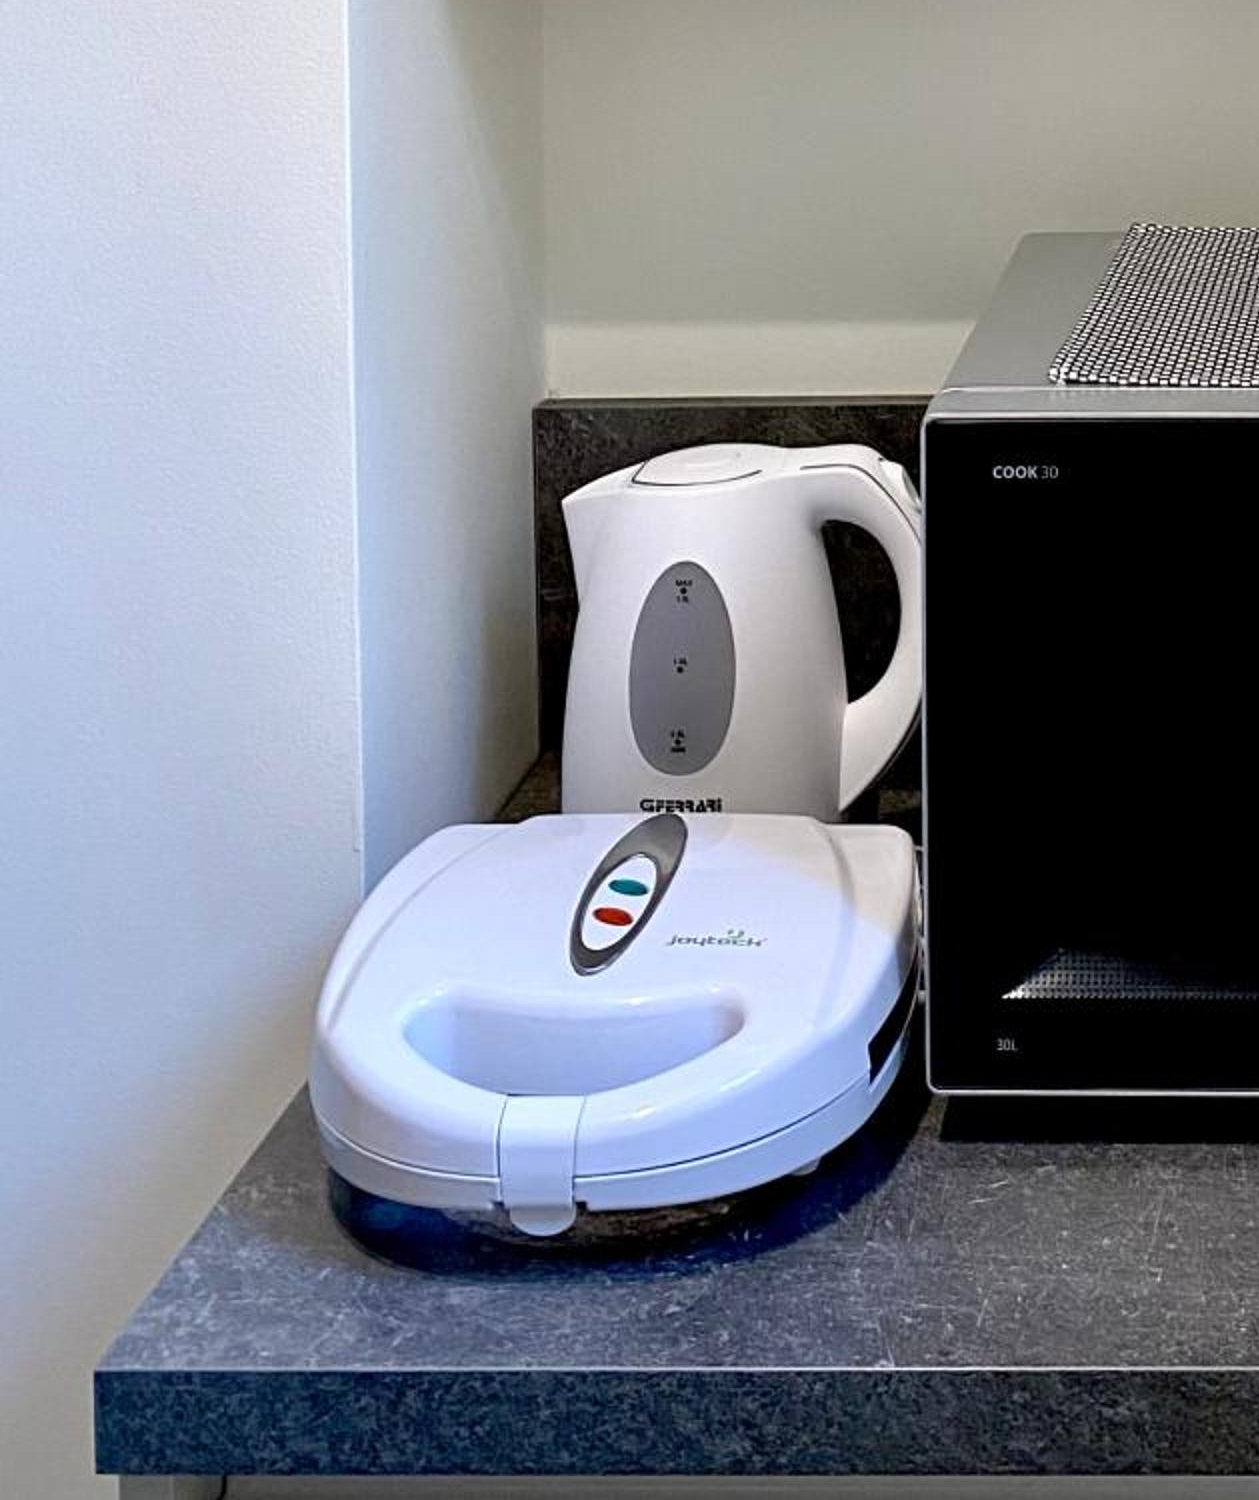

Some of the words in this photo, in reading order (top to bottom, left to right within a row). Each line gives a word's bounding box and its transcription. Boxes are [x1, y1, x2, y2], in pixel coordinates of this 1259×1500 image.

[992, 465, 1037, 479] COOK
[1041, 465, 1058, 479] 30
[997, 1037, 1018, 1051] 30L
